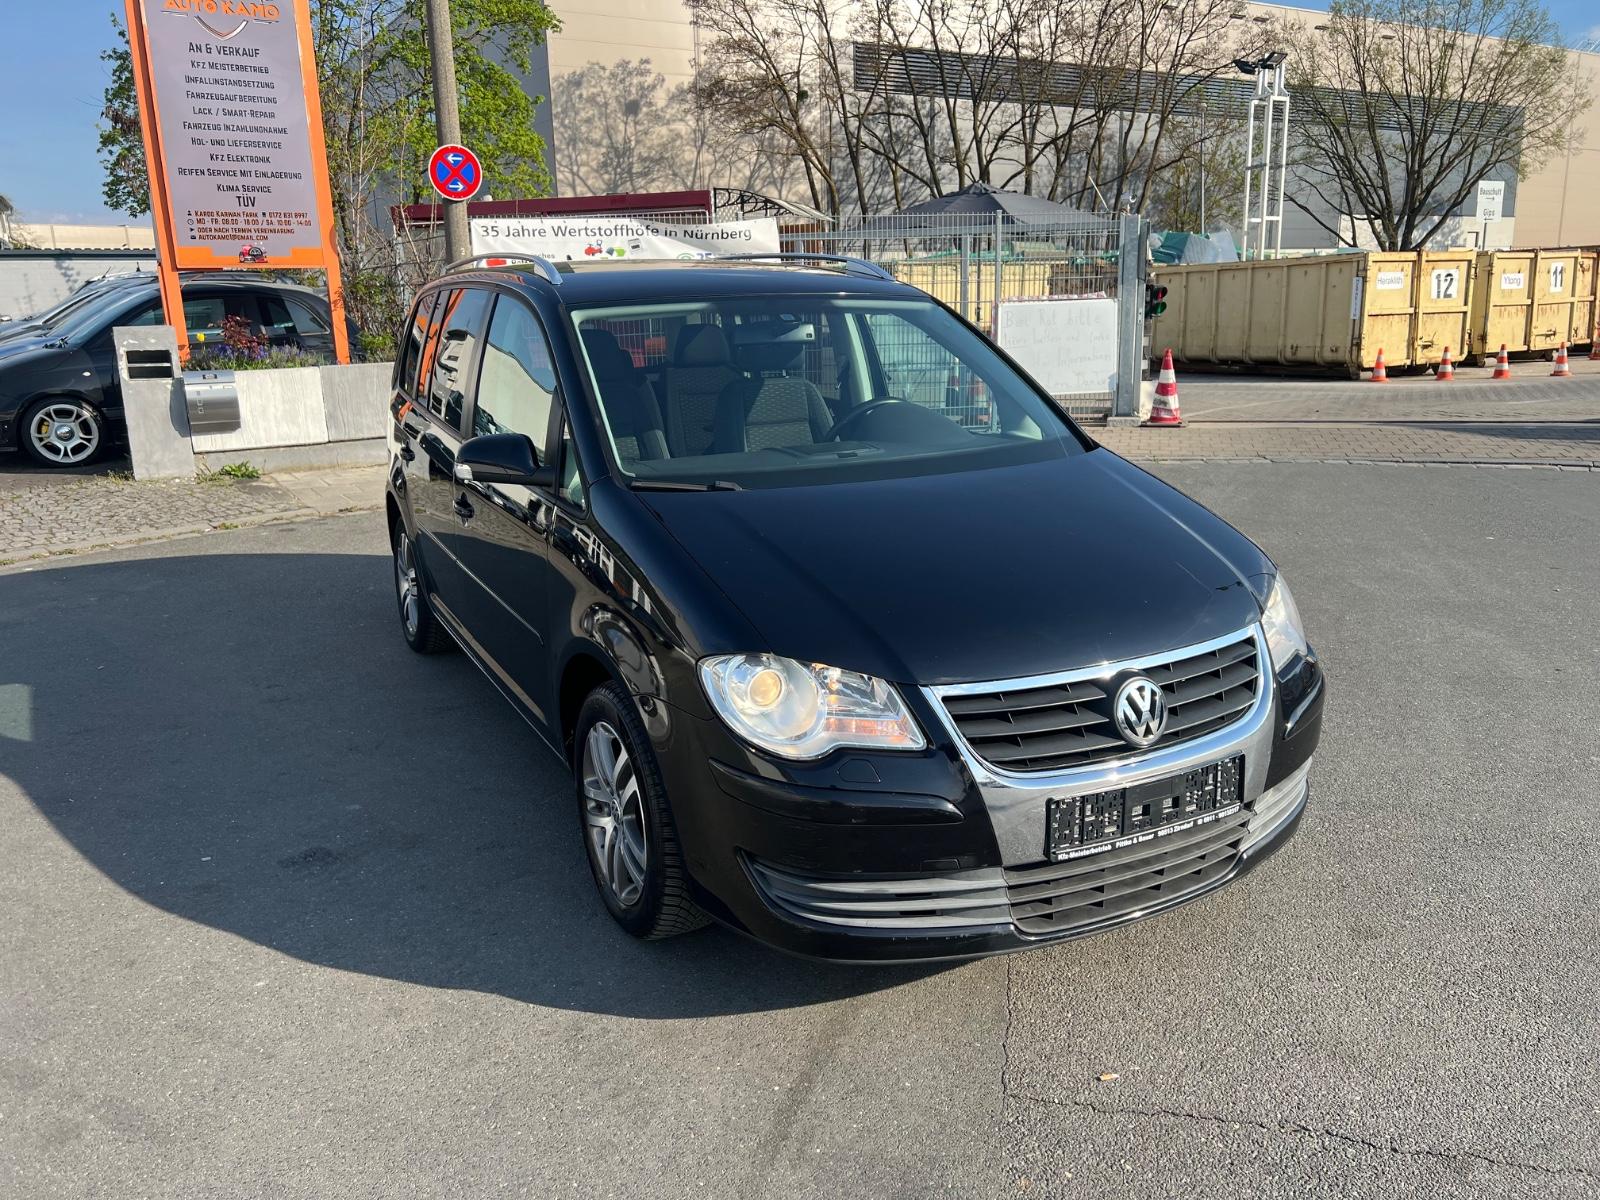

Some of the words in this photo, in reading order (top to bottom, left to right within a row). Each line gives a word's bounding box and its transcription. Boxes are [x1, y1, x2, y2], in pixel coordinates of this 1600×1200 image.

[188, 42, 203, 54] AN
[205, 43, 213, 55] &
[215, 45, 260, 58] VERKAUF
[208, 61, 270, 75] MEISTERBETRIEB
[186, 90, 278, 105] FAHRZEUGAUFBEREITUNG
[192, 106, 213, 116] LACK
[183, 121, 222, 132] FAHRZEUG
[227, 139, 283, 150] LIEFERSERVICE
[226, 154, 272, 165] ELEKTRONIK
[177, 167, 206, 177] REIFEN
[206, 168, 239, 179] SERVICE
[254, 170, 303, 181] EINLAGERUNG
[216, 183, 241, 193] KLIMA
[241, 184, 273, 195] SERVICE
[235, 193, 257, 208] TÜV
[481, 225, 500, 238] 35
[505, 225, 547, 238] Jahre
[551, 224, 660, 239] Wertstoffhöfe
[664, 226, 678, 238] in
[683, 227, 753, 242] Nürnberg
[1552, 265, 1564, 288] 11
[1434, 272, 1454, 299] 12
[1116, 677, 1168, 746] VW
